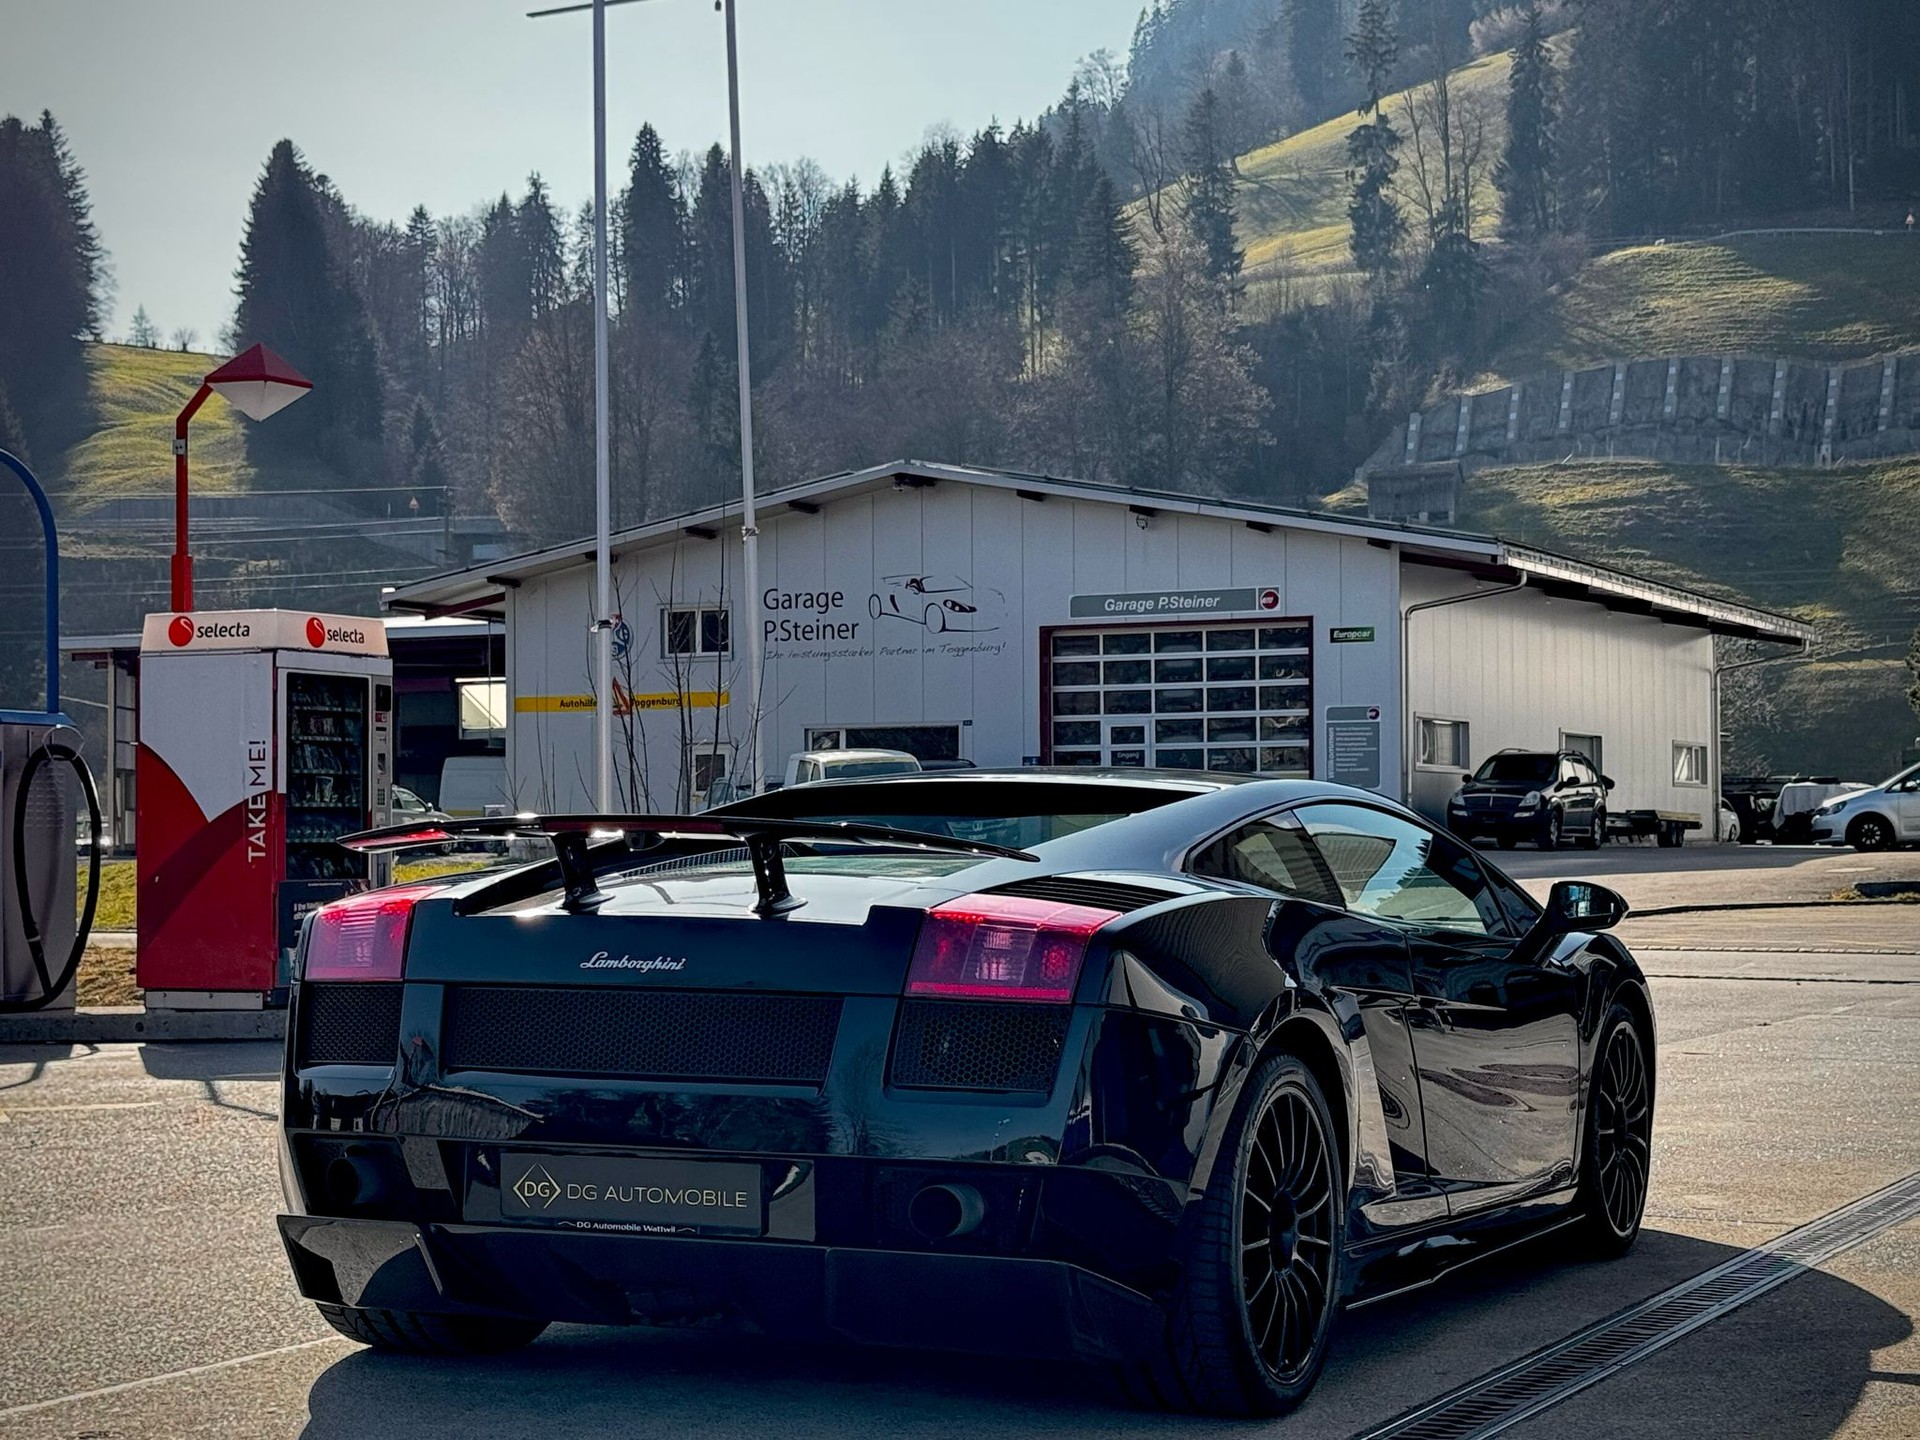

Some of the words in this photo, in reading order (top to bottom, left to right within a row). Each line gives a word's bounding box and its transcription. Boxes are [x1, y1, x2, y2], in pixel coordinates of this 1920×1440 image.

[763, 588, 844, 614] Garage
[1104, 598, 1154, 613] Garage
[1158, 595, 1220, 609] P.Steiner
[197, 622, 250, 638] selecta
[327, 628, 365, 644] selecta
[764, 618, 859, 642] P.Steiner
[1333, 630, 1371, 640] Europcar
[880, 646, 917, 656] Partner
[922, 647, 935, 655] im
[940, 642, 1006, 658] Toggenburg!
[248, 740, 266, 786] ME!
[248, 794, 266, 863] TAKE
[580, 951, 686, 973] Lamborghini
[524, 1181, 550, 1198] DG
[567, 1184, 597, 1200] DG
[604, 1186, 748, 1208] AUTOMOBILE
[576, 1221, 591, 1229] DG
[592, 1222, 641, 1232] Automobile
[643, 1224, 676, 1233] Wattwil
